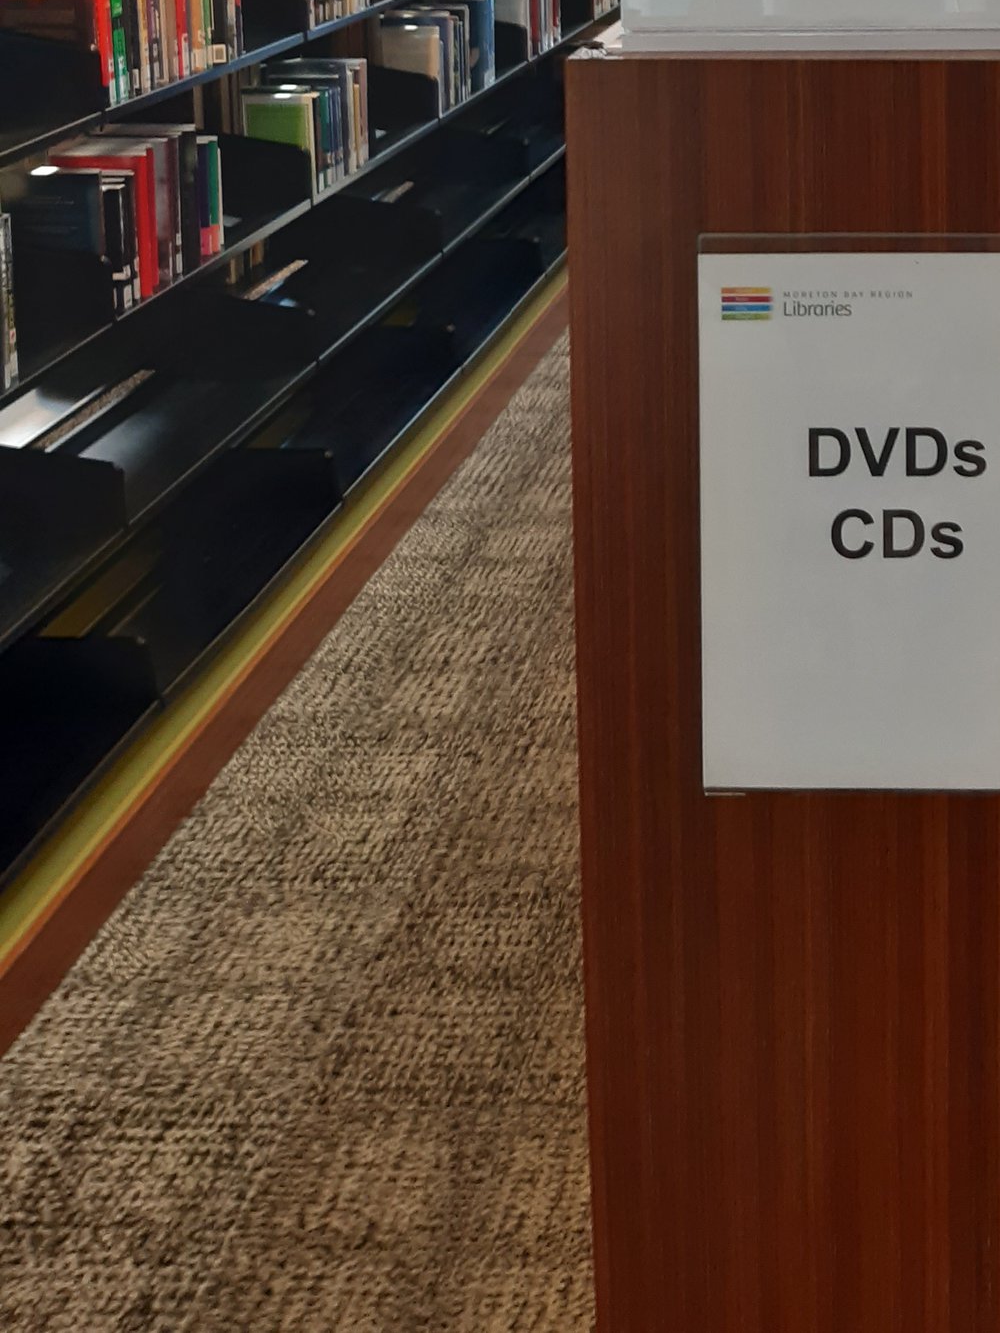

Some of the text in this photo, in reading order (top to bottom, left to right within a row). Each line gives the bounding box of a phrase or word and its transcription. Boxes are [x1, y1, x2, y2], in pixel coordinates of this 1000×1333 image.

[783, 290, 913, 299] MORETON BAY REGION
[783, 300, 852, 317] Libraries
[808, 427, 987, 478] DVDs
[830, 508, 964, 560] CDs
